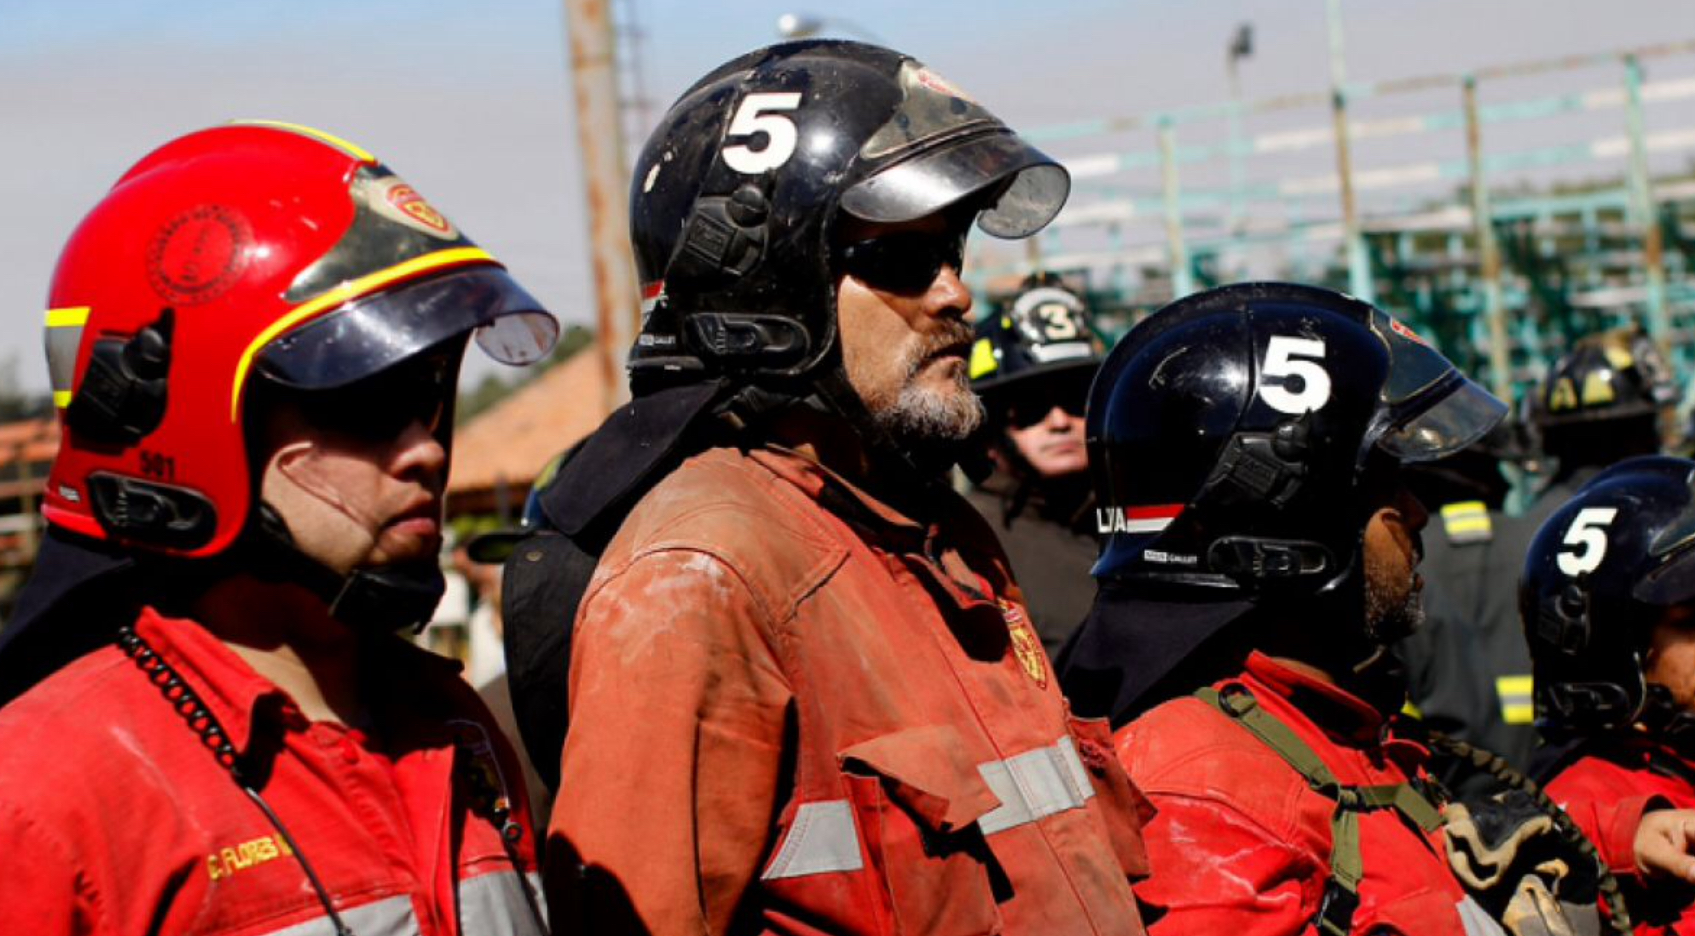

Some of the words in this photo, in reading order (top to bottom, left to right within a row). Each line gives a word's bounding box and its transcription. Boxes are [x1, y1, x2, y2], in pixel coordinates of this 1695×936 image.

[722, 92, 802, 174] 5
[1040, 303, 1076, 340] 3
[1259, 335, 1331, 414] 5
[1557, 508, 1618, 577] 5
